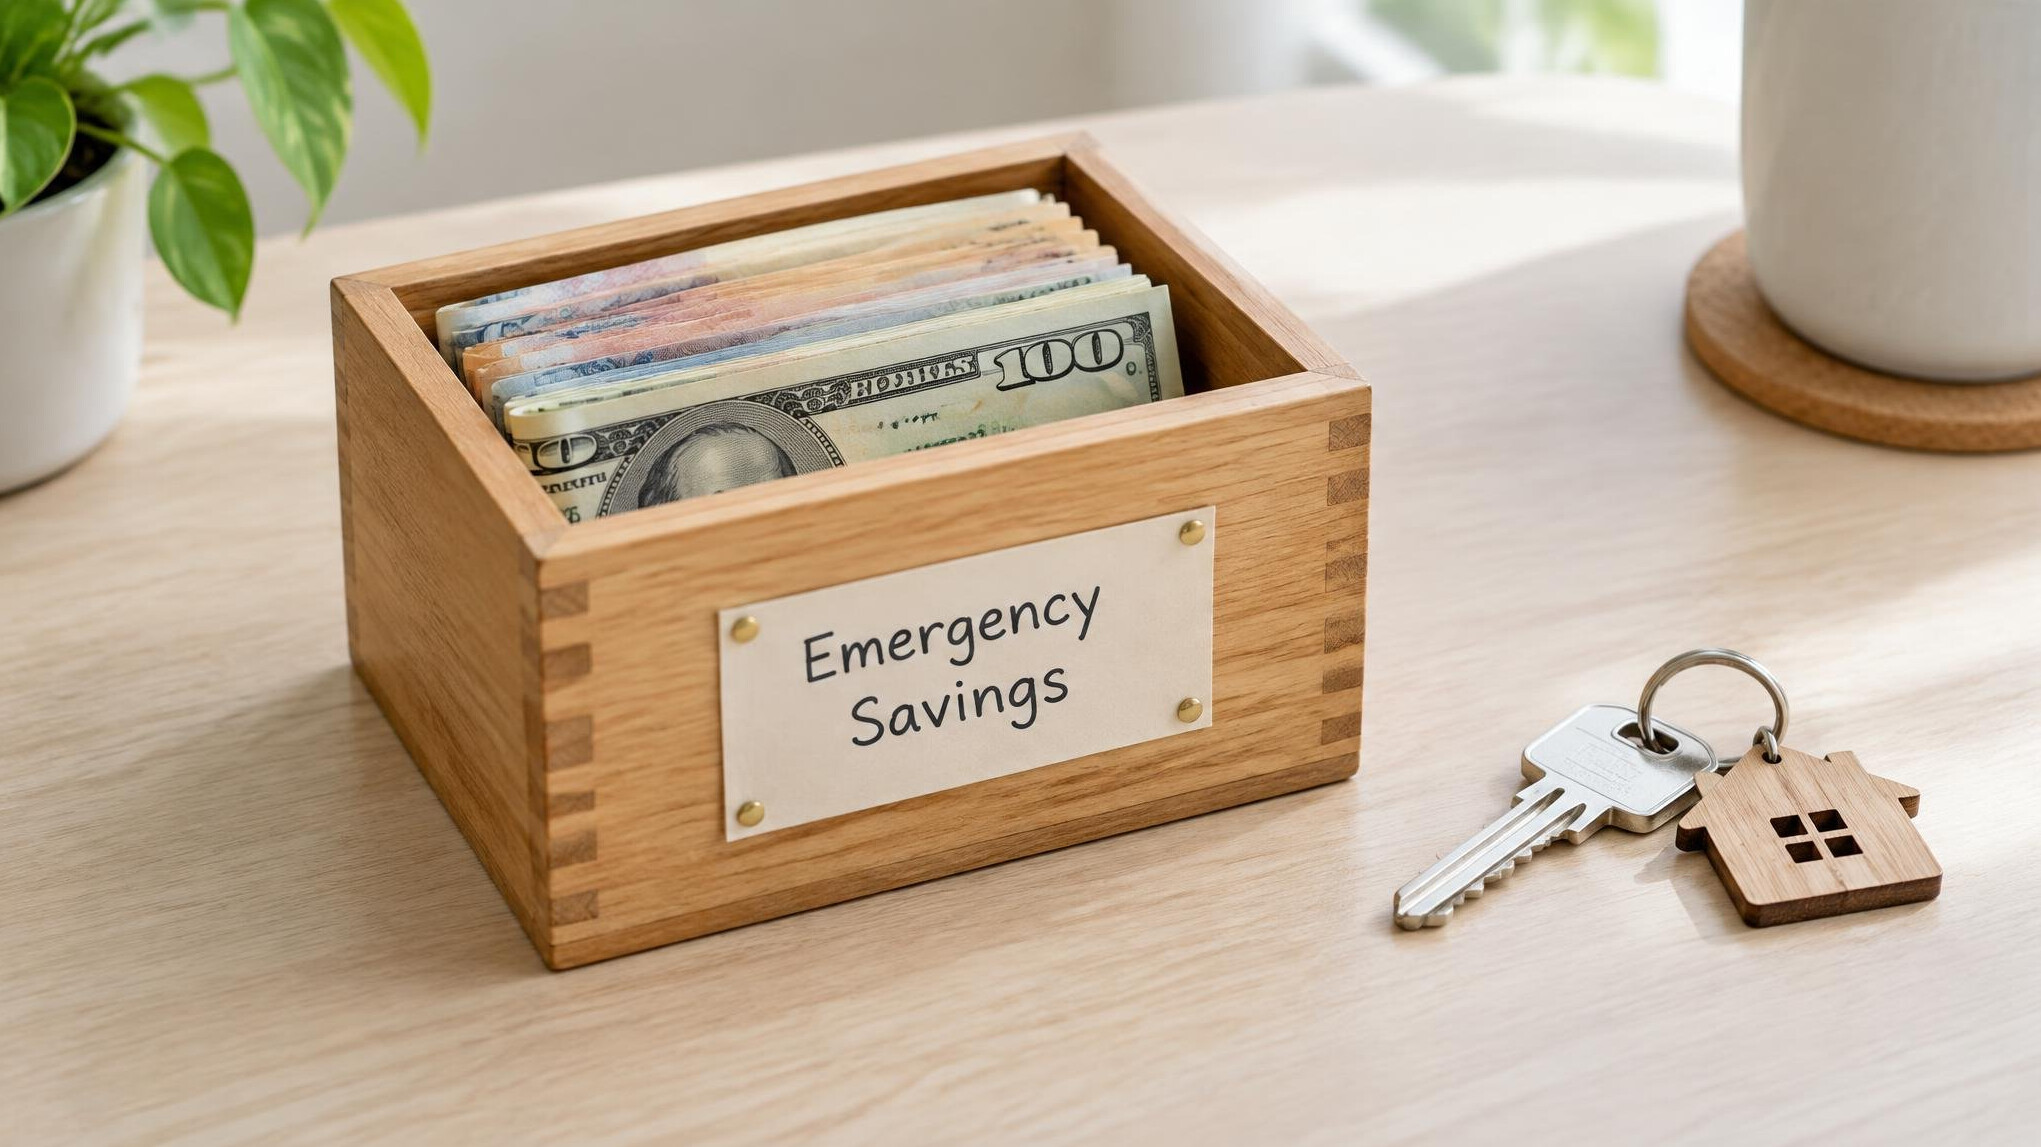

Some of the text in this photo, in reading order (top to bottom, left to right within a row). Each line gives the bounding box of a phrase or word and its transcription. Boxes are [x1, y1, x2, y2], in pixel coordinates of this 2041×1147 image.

[994, 328, 1124, 392] 100
[804, 585, 1101, 683] Emergency
[851, 667, 1069, 746] Savings
